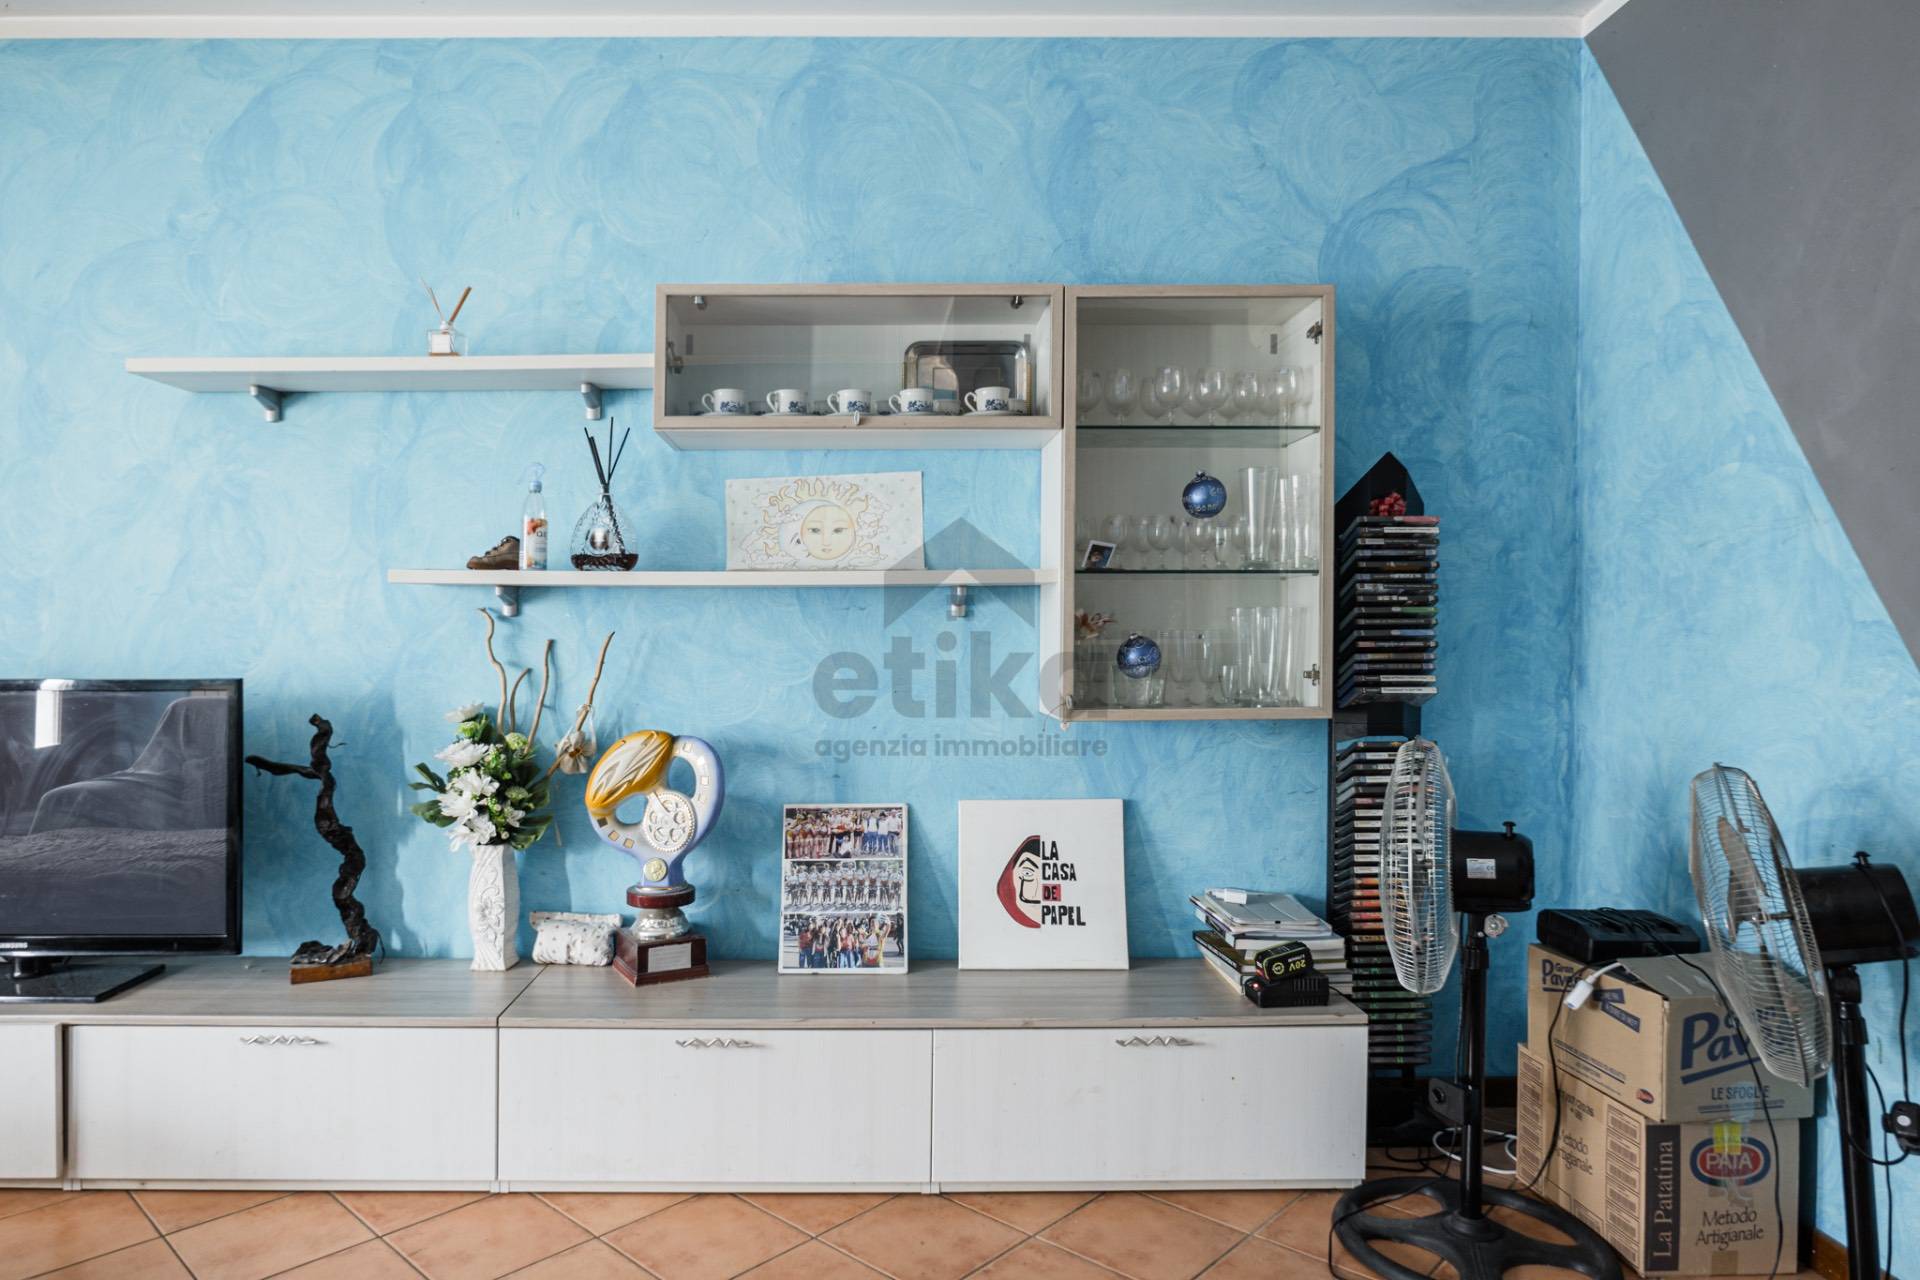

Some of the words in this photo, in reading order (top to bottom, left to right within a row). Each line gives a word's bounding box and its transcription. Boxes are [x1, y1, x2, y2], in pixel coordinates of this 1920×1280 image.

[1041, 840, 1059, 861] LA
[1041, 862, 1077, 881] CASA
[1042, 885, 1057, 900] DE
[1041, 904, 1086, 926] PAPEL
[1289, 959, 1306, 972] 20V
[1711, 1087, 1724, 1100] LE
[1727, 1085, 1770, 1100] SFOGLE
[1654, 1141, 1673, 1224] Patatina
[1701, 1206, 1758, 1227] Metodo
[1653, 1231, 1673, 1257] La
[1695, 1224, 1765, 1251] Artigianale
